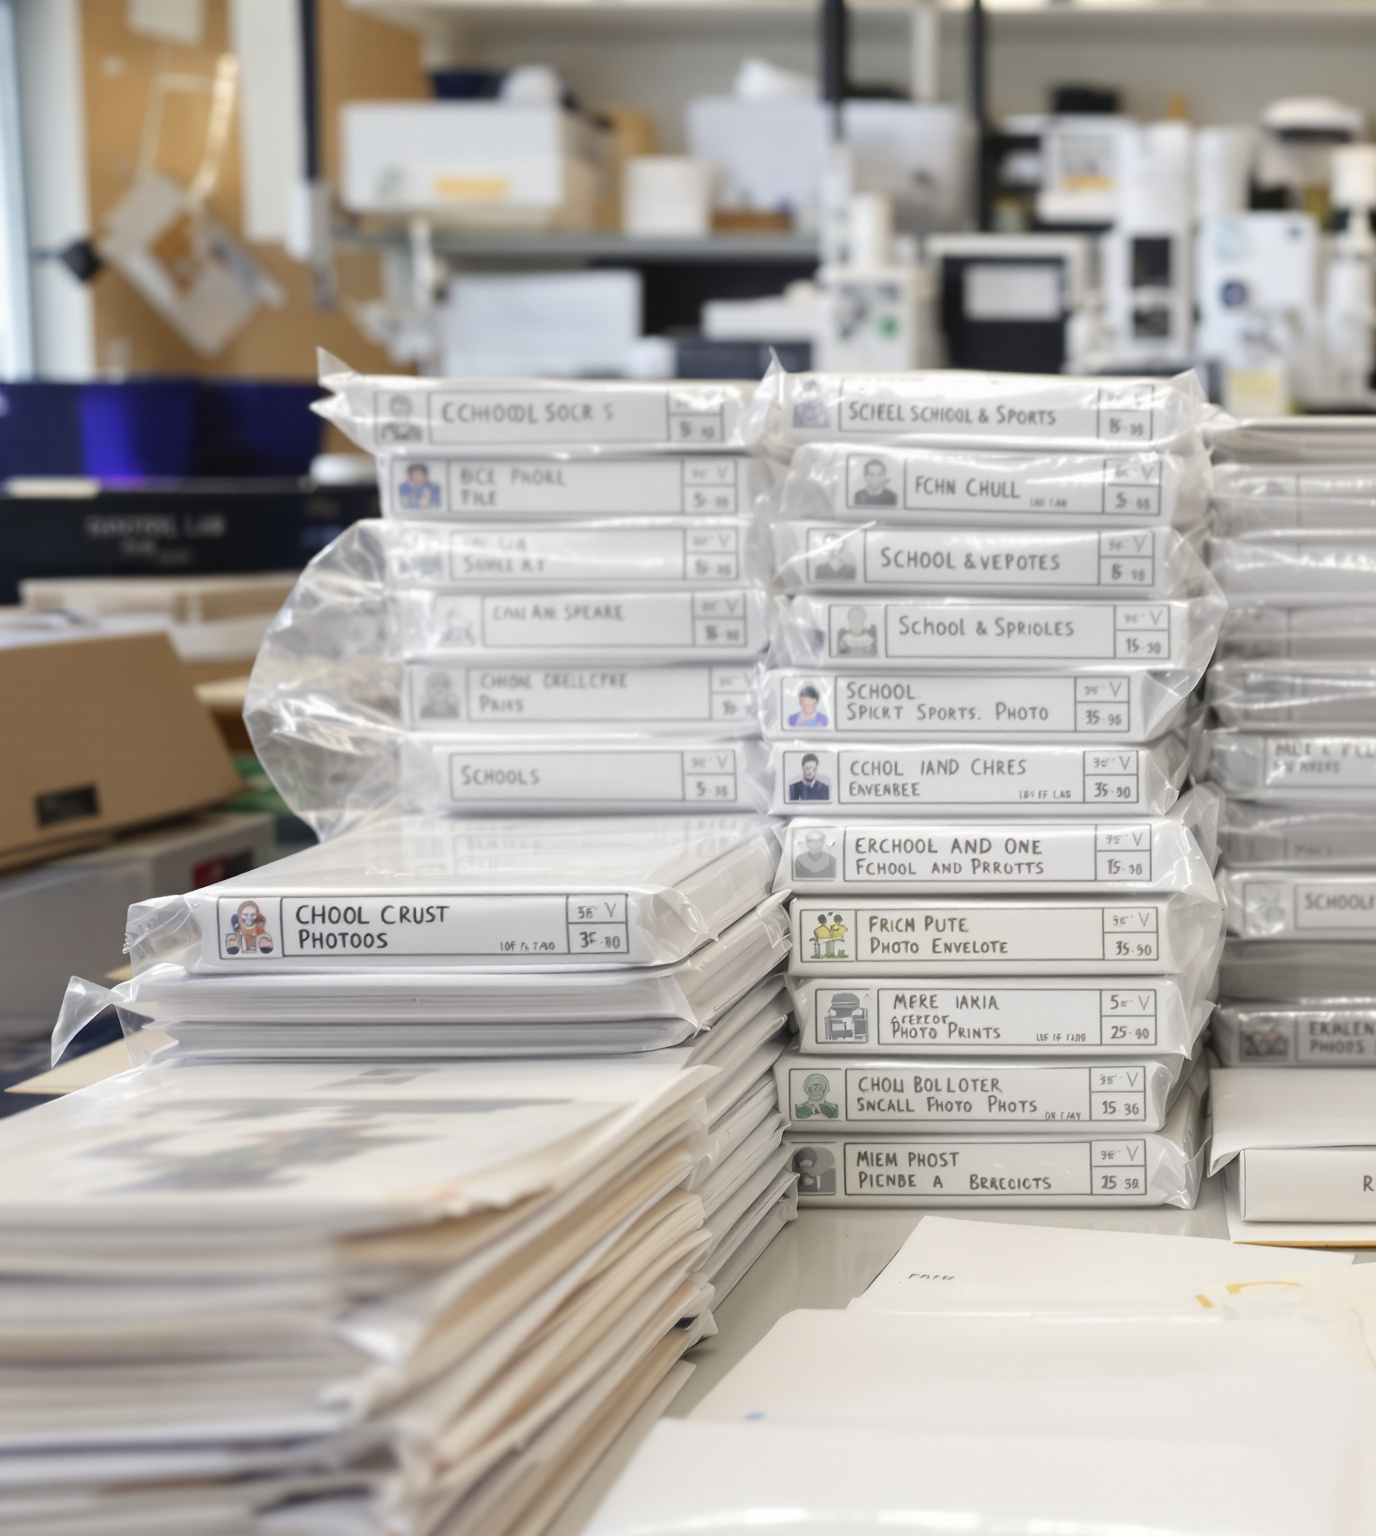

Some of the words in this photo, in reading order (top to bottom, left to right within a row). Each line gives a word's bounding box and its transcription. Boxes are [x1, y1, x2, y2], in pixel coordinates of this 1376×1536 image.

[978, 409, 990, 423] &
[997, 406, 1056, 425] SPORTS
[881, 547, 956, 569] SCHOOL
[899, 615, 966, 636] School
[976, 621, 988, 636] &
[996, 702, 1049, 721] PHOTO
[460, 765, 540, 786] SCHOOLS
[971, 758, 1027, 776] CHRES
[950, 838, 992, 854] AND
[1004, 838, 1043, 855] ONE
[856, 858, 917, 875] FCHOOL
[931, 862, 963, 874] AND
[295, 904, 370, 925] CHOOL
[380, 904, 450, 925] CRUST
[924, 915, 969, 933] PUTE
[298, 928, 389, 949] PHOTOOS
[931, 938, 1009, 954] ENVELOTE
[948, 1021, 1001, 1039] PRINTS
[908, 1152, 960, 1168] PHOST
[933, 1175, 943, 1188] A
